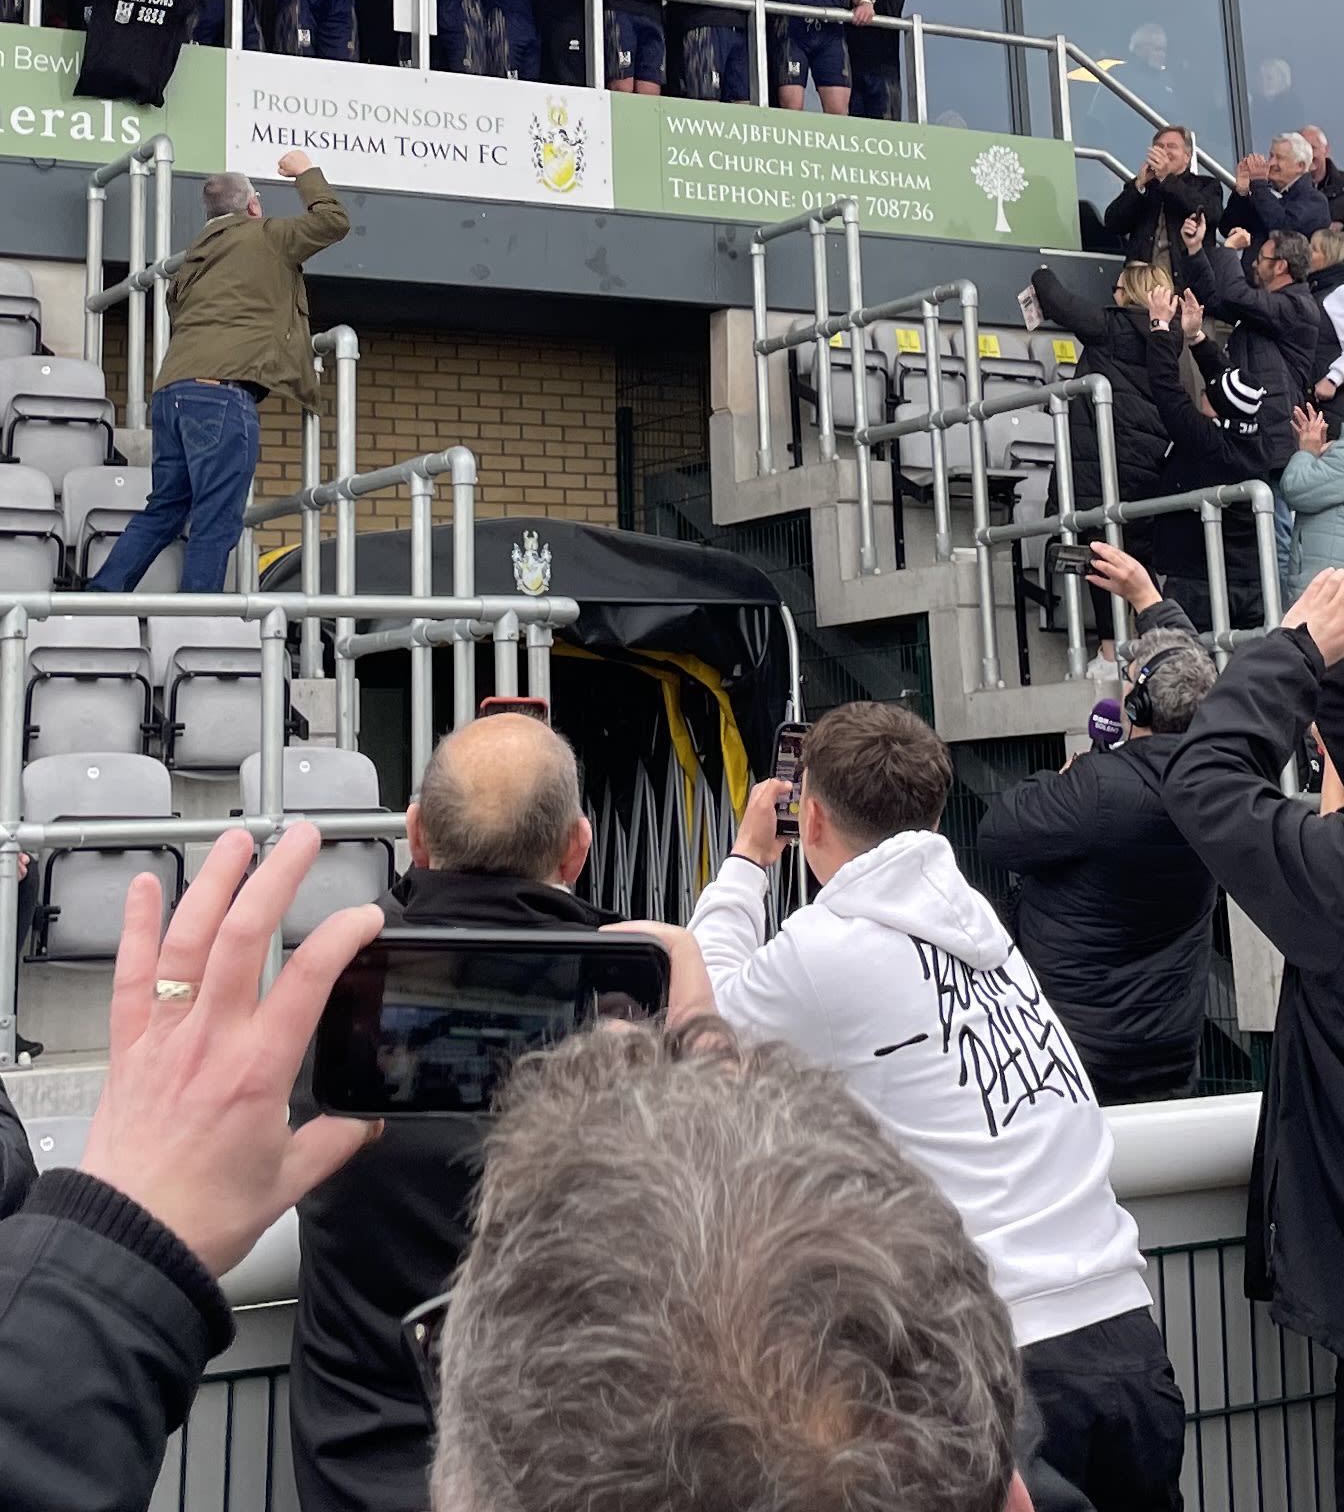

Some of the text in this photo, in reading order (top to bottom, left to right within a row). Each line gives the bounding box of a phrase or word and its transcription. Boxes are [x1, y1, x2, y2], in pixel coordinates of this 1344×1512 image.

[14, 46, 81, 75] Bewl
[666, 116, 927, 161] WWW.AJBFUNERALS.CO.UK
[478, 144, 508, 167] FC
[667, 146, 704, 169] 26A
[801, 190, 859, 210] 012
[865, 196, 935, 222] 708736
